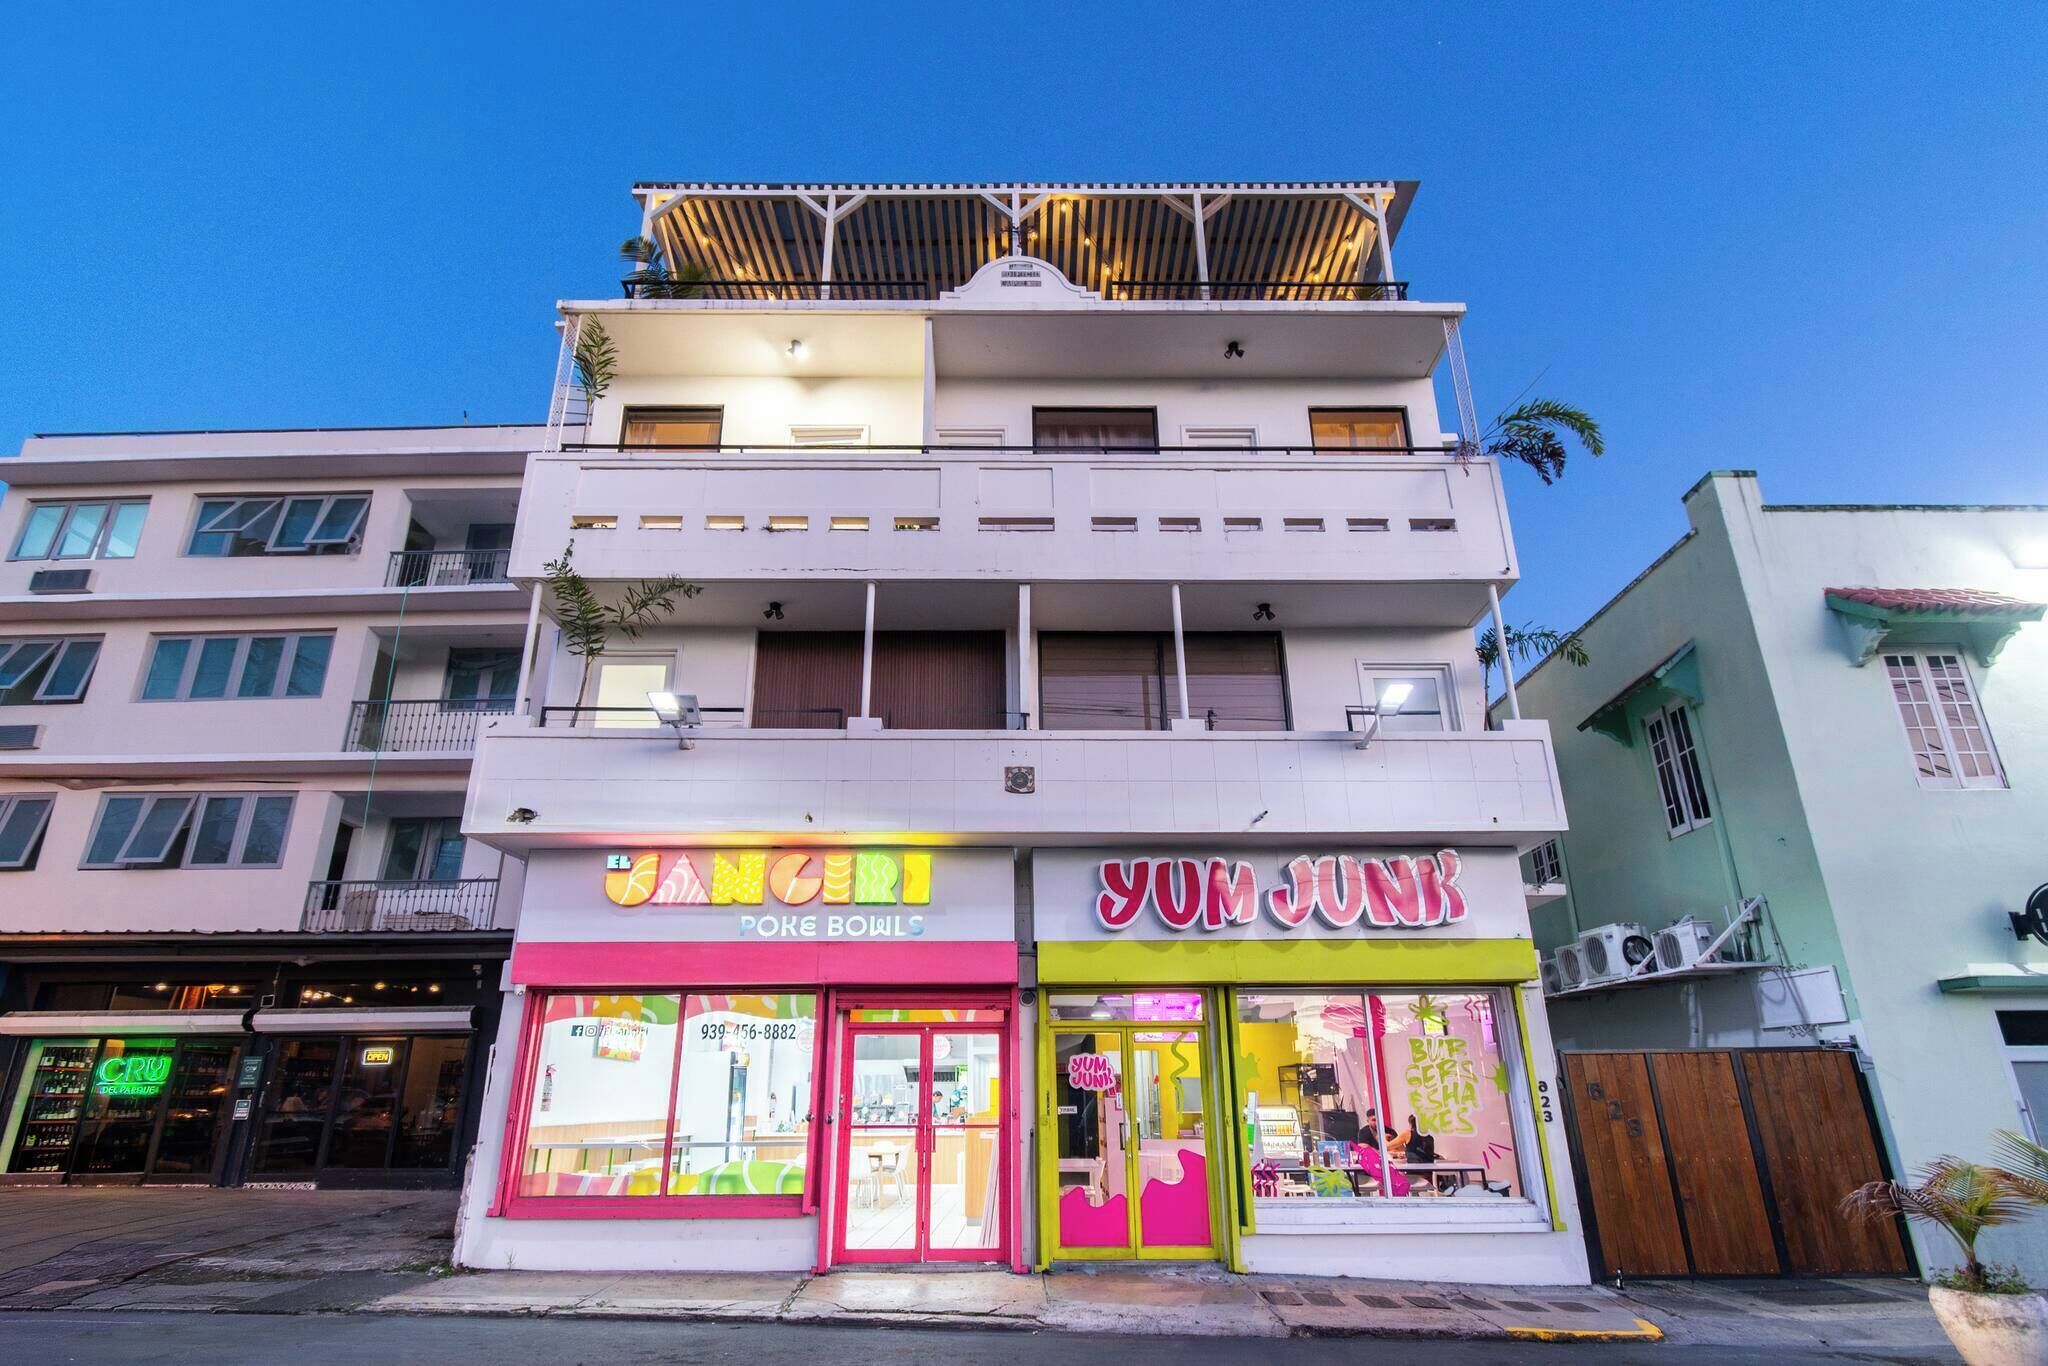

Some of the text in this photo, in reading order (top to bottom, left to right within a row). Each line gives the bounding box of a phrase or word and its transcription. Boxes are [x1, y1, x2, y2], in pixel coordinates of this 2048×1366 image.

[1096, 848, 1470, 932] YUM JUNK
[739, 915, 925, 937] POKE BOWLS
[701, 1023, 797, 1040] 939-456-8882
[366, 1052, 389, 1061] OPEN
[1071, 1056, 1107, 1073] YUM
[100, 1056, 172, 1082] CRU
[1072, 1067, 1113, 1088] JUNK
[101, 1086, 157, 1095] DEL PARQUE
